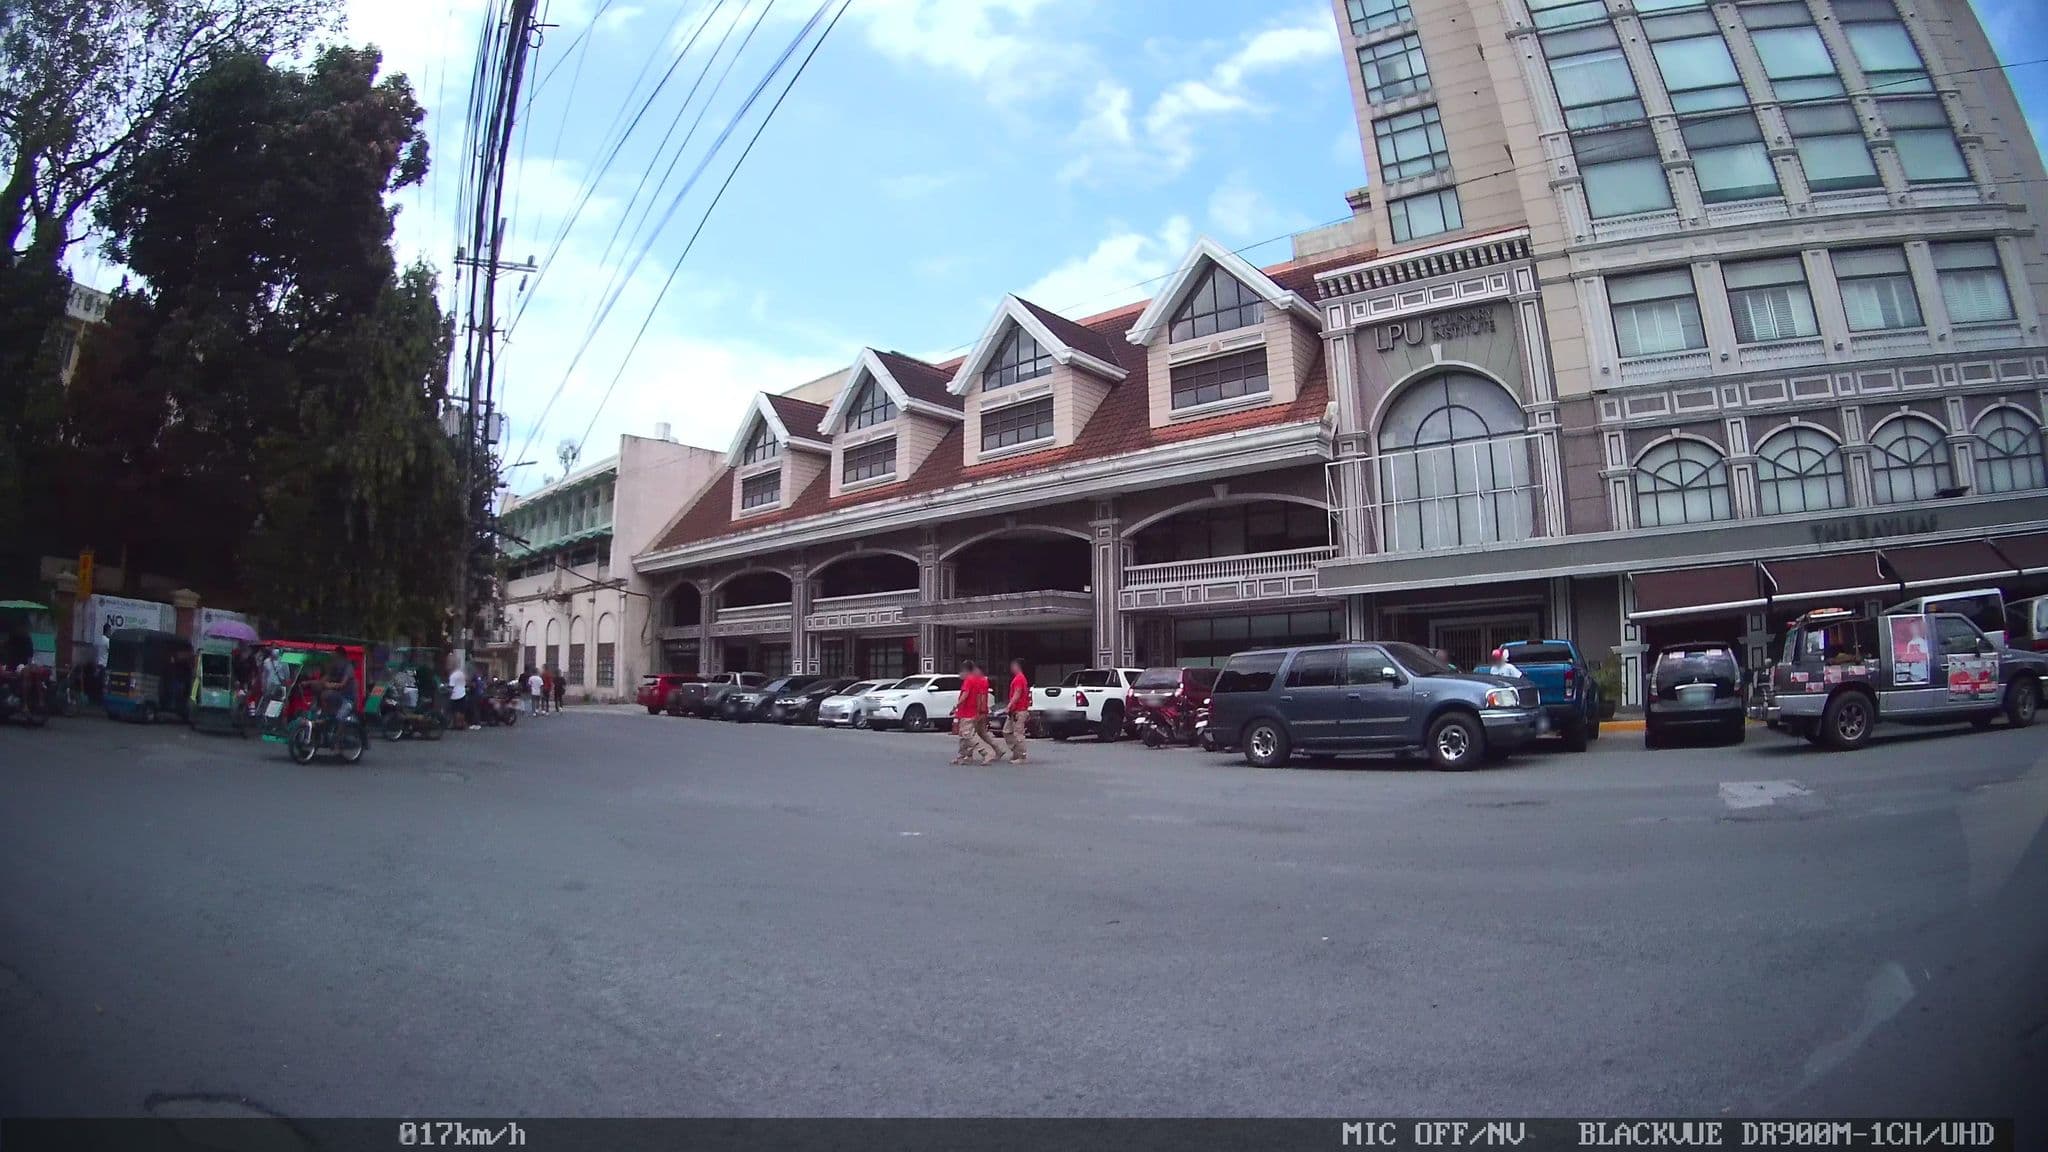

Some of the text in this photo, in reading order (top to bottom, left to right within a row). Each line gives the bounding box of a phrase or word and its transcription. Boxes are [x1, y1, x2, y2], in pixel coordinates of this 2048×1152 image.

[1429, 306, 1494, 329] CULINARY
[1373, 319, 1425, 353] LPU
[106, 614, 124, 627] NO
